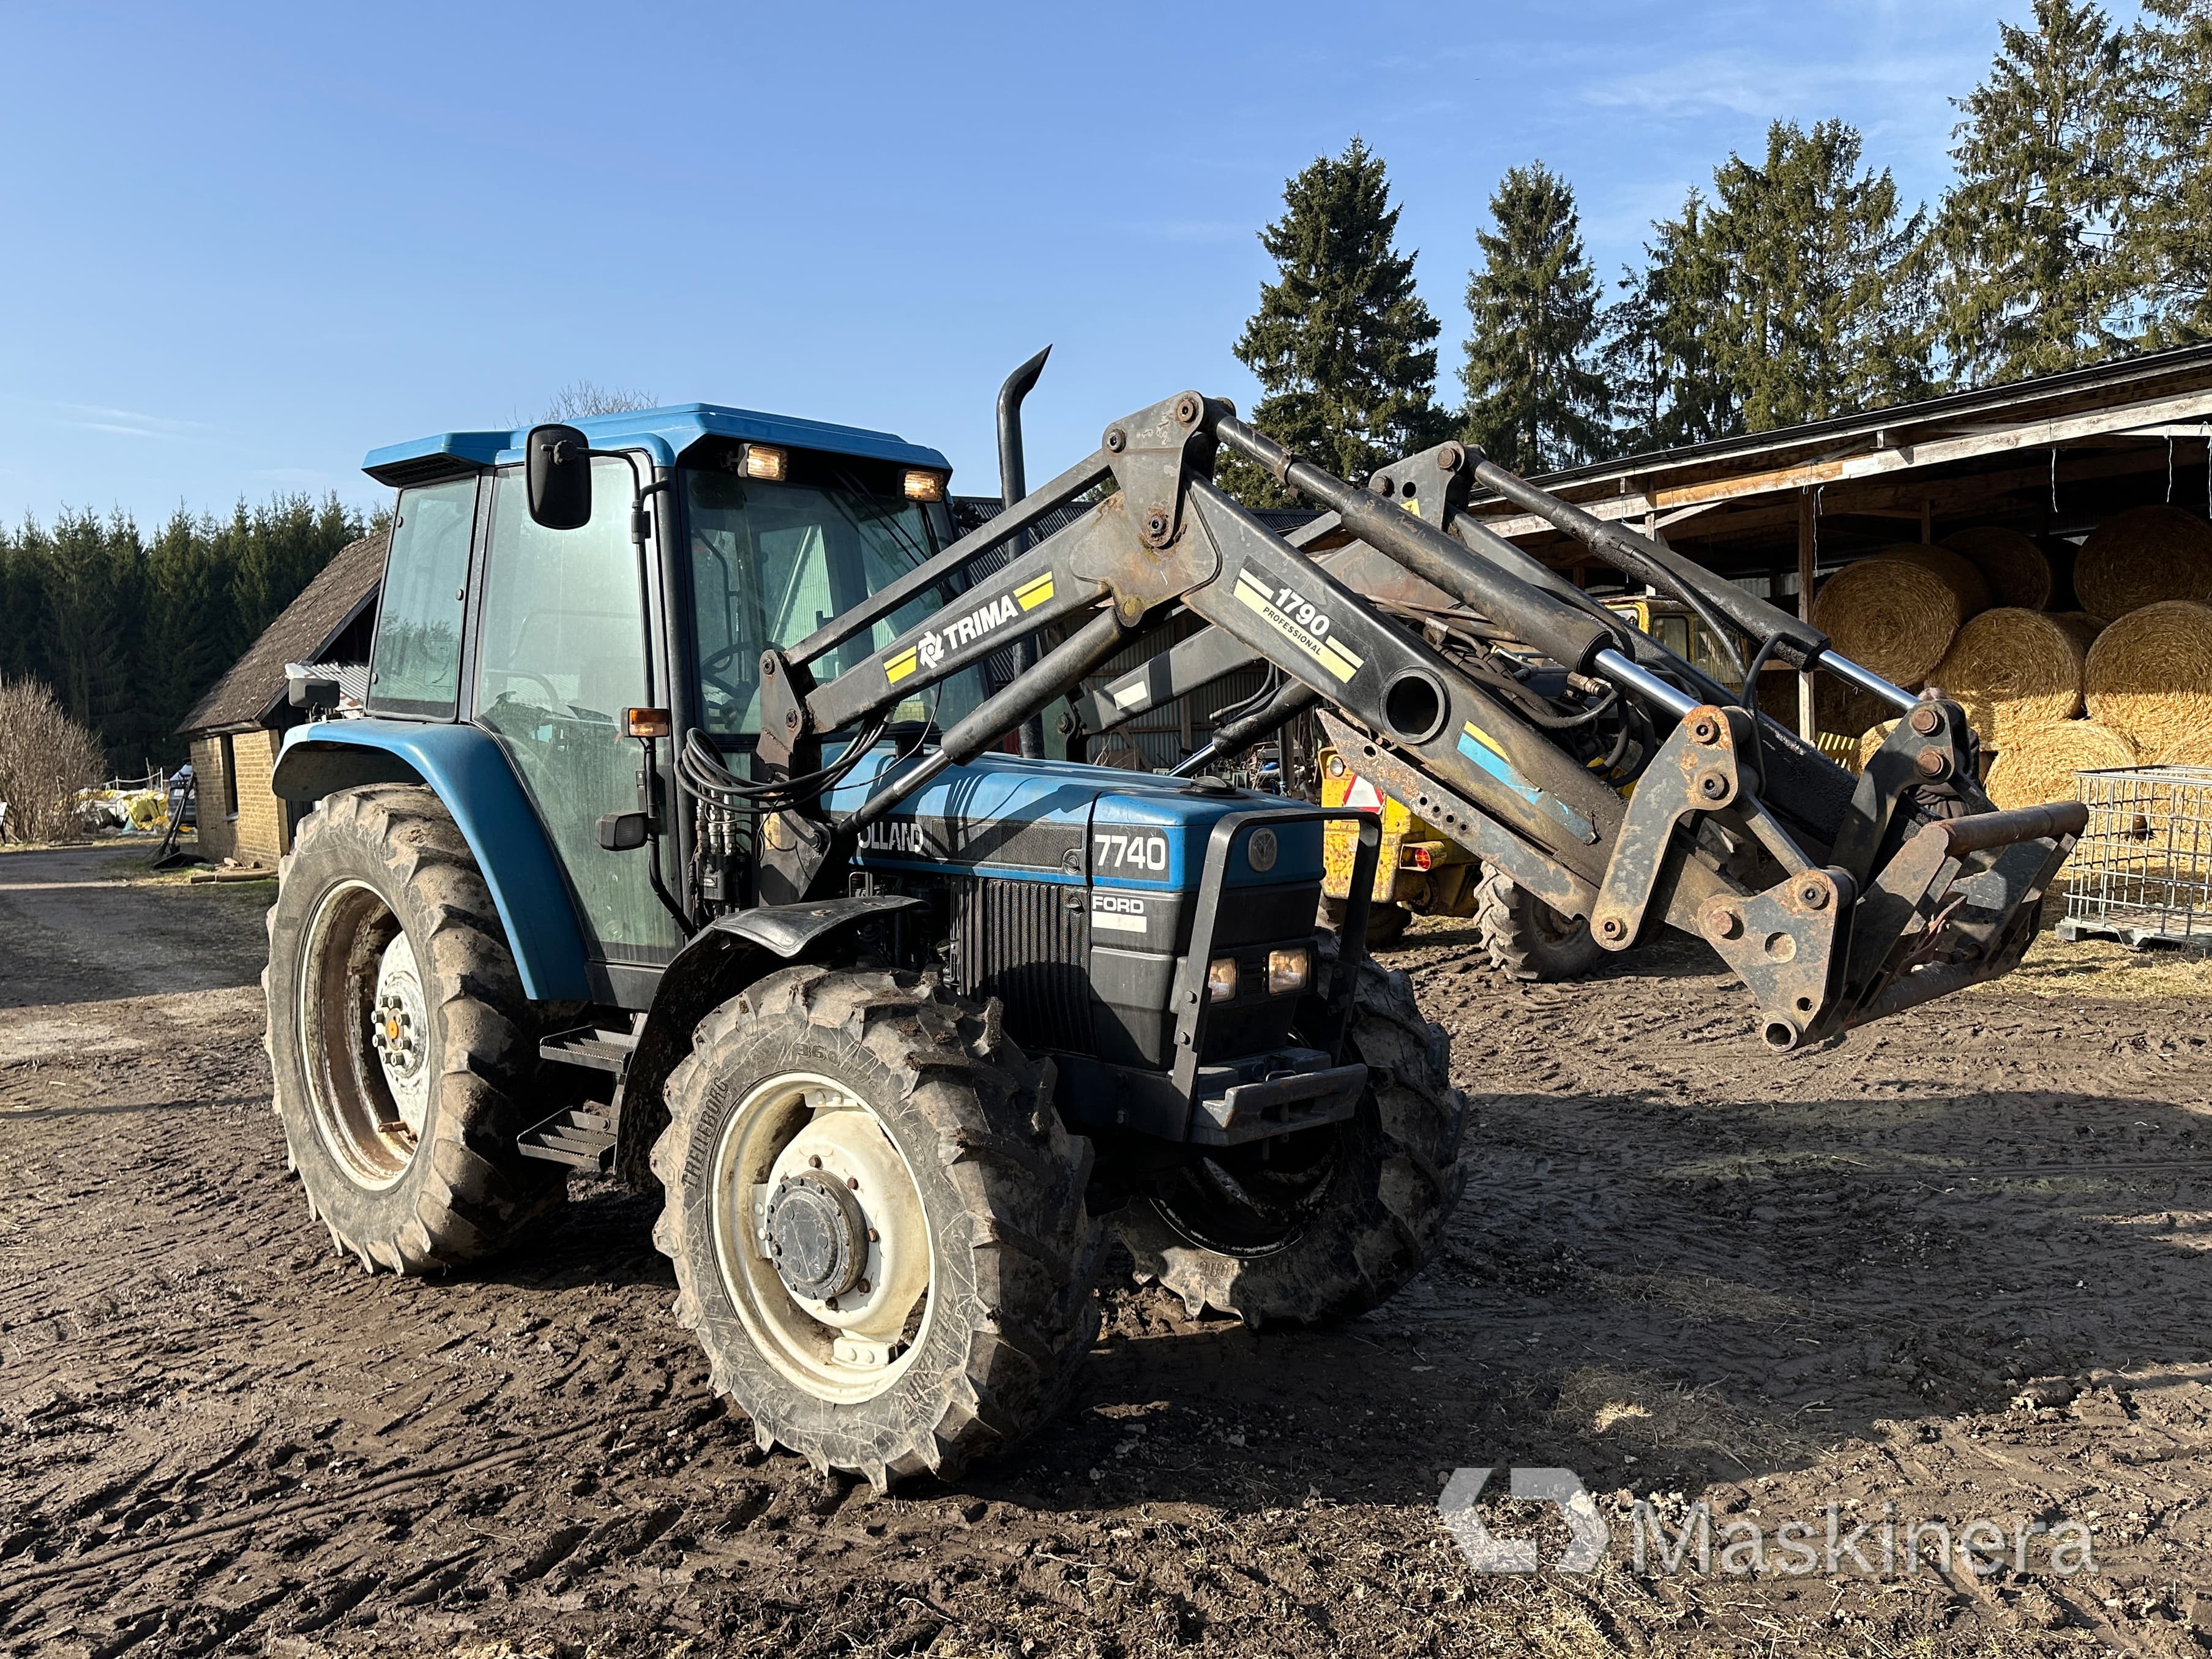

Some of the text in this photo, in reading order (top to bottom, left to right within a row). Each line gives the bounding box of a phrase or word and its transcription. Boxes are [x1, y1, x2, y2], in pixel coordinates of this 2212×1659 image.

[943, 594, 1018, 650] TRIMA
[1263, 606, 1321, 656] PROFESSIONAL
[1275, 588, 1330, 635] 1790
[857, 821, 924, 853] OLLAND
[1094, 834, 1166, 871] 7740
[1092, 896, 1145, 915] FORD
[681, 1076, 729, 1189] TRELLEBORG
